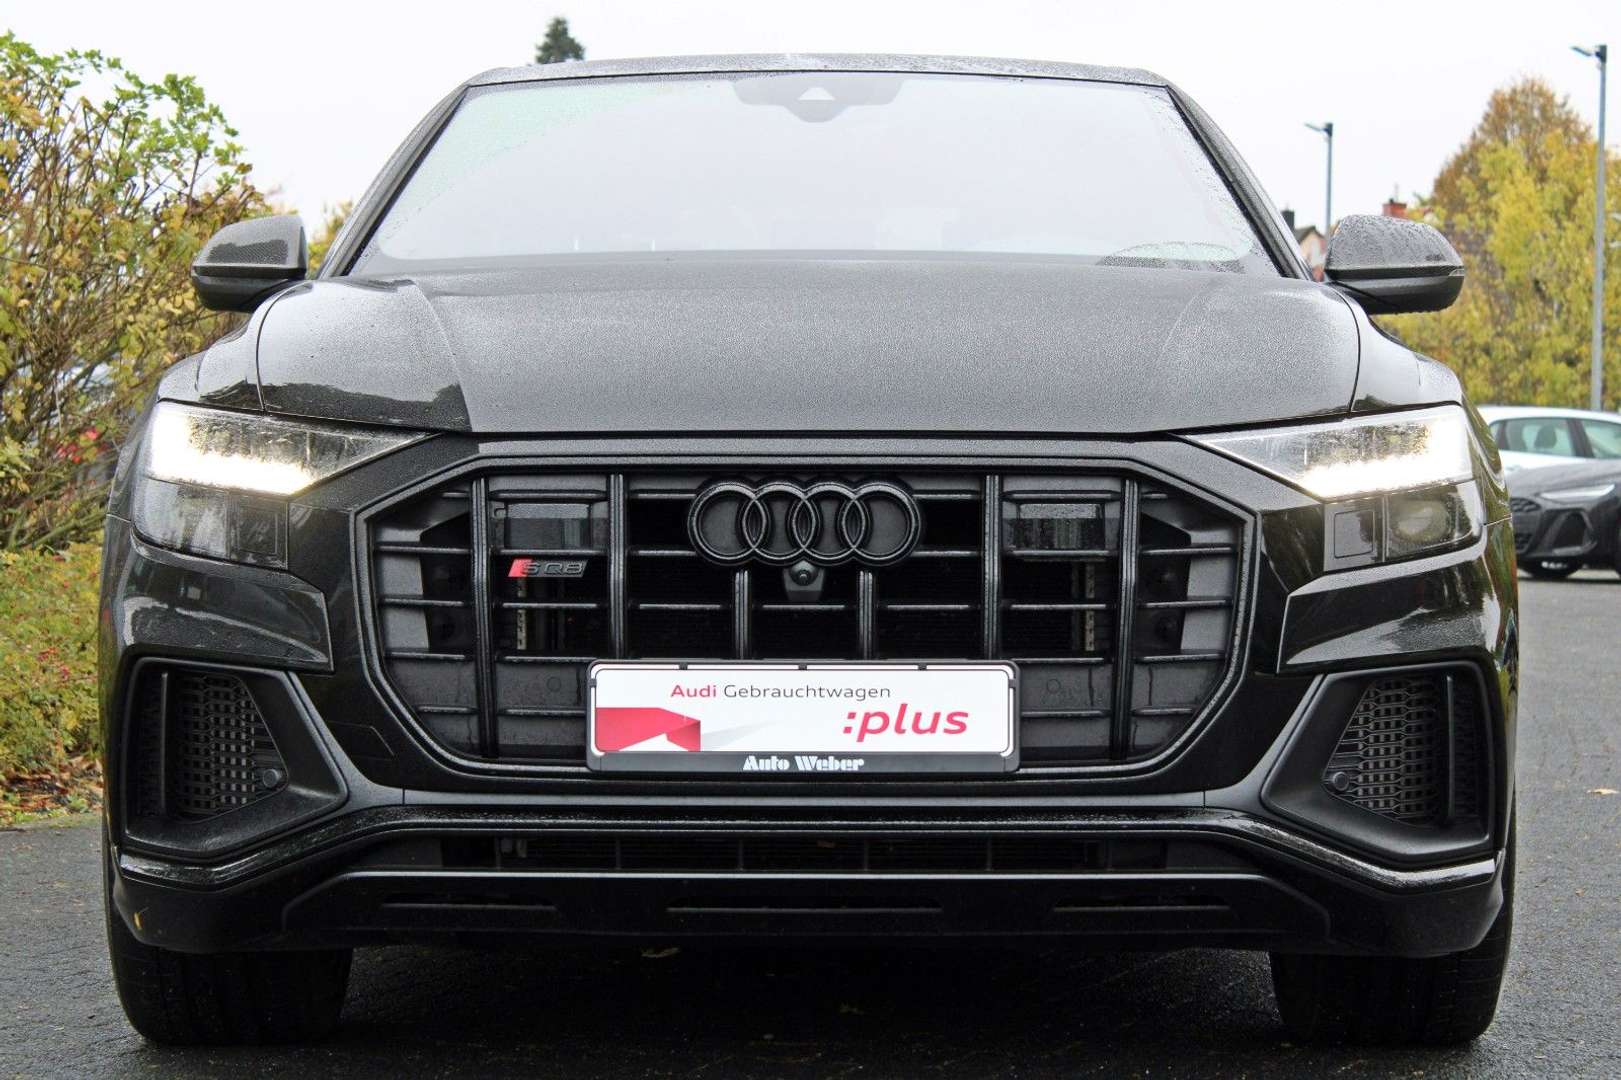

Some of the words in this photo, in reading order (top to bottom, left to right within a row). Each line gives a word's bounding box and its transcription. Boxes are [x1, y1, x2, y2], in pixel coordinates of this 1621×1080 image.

[670, 684, 718, 699] Audi
[723, 684, 892, 702] Gebrauchtwagen
[742, 755, 791, 772] Auto
[795, 755, 865, 772] Weber
